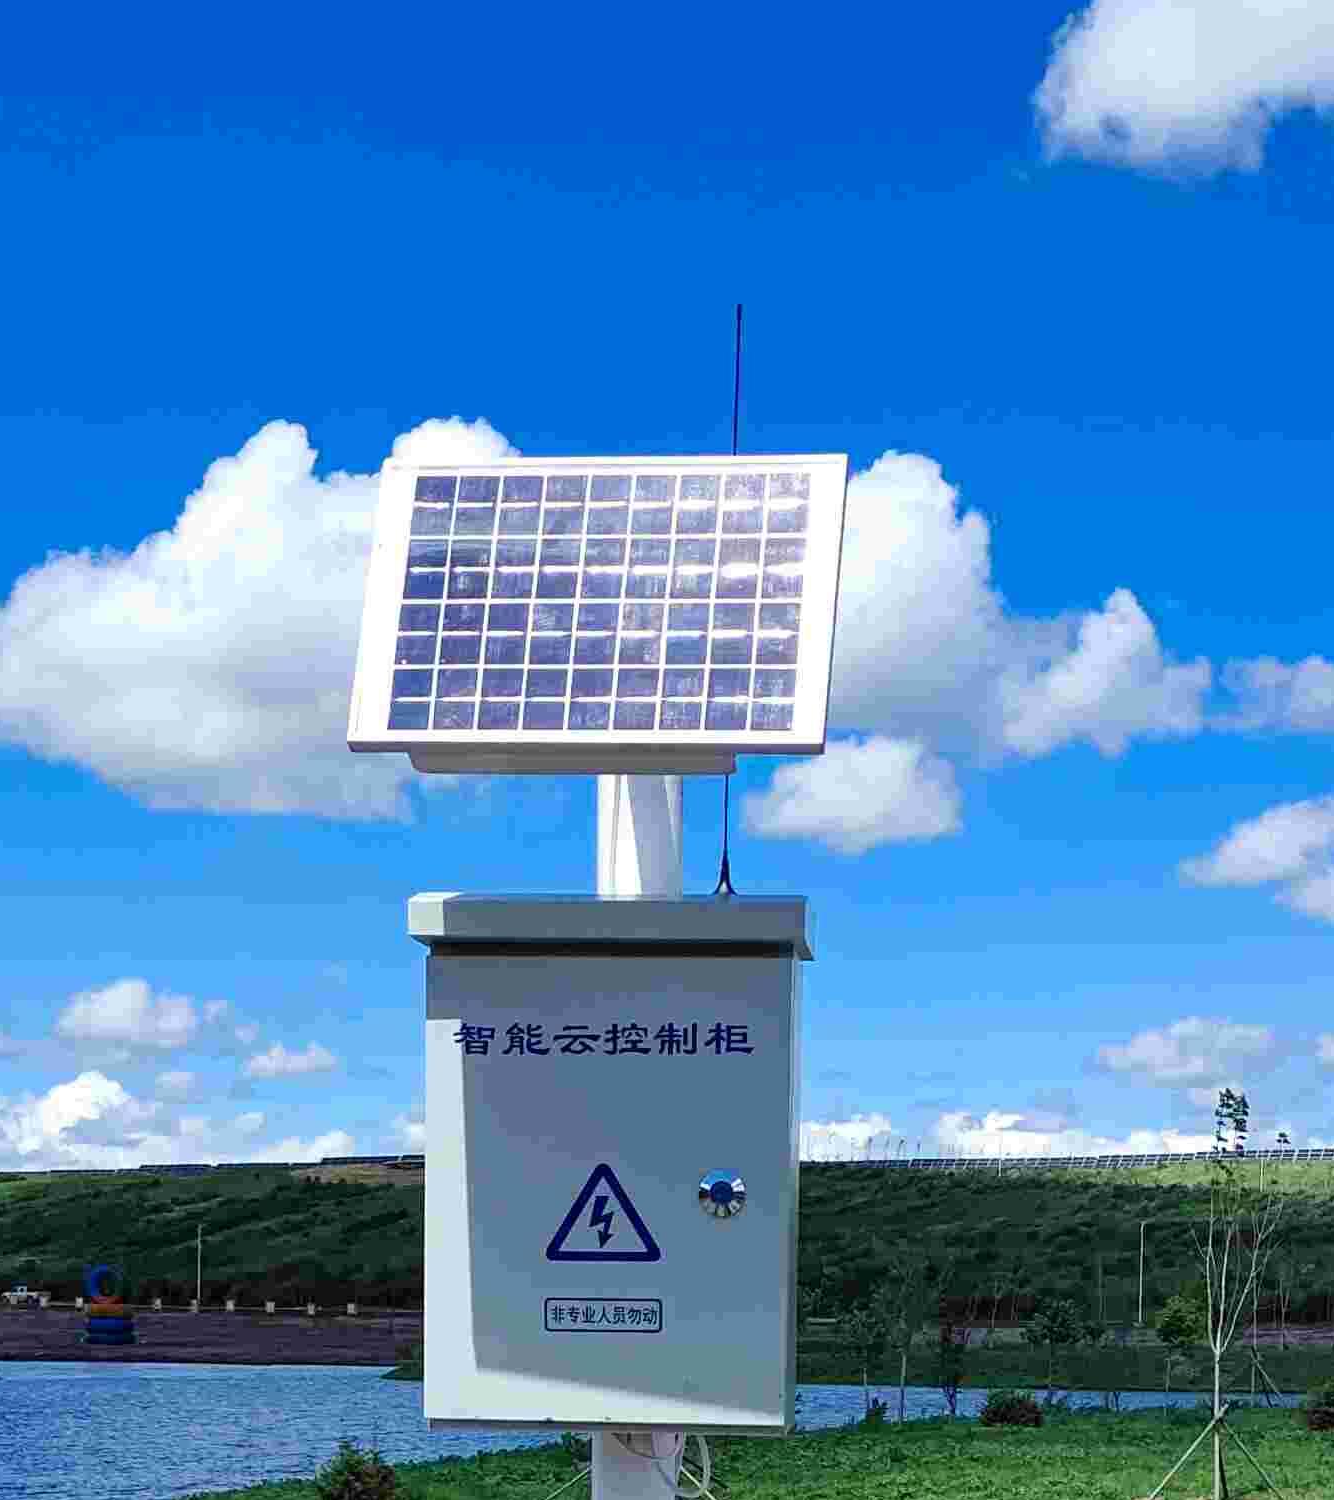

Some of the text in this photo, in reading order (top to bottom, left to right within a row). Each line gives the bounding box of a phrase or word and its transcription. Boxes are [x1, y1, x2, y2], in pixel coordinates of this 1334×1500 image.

[453, 1022, 755, 1056] 智能云控制柜
[550, 1304, 659, 1326] 非专业人员勿动
